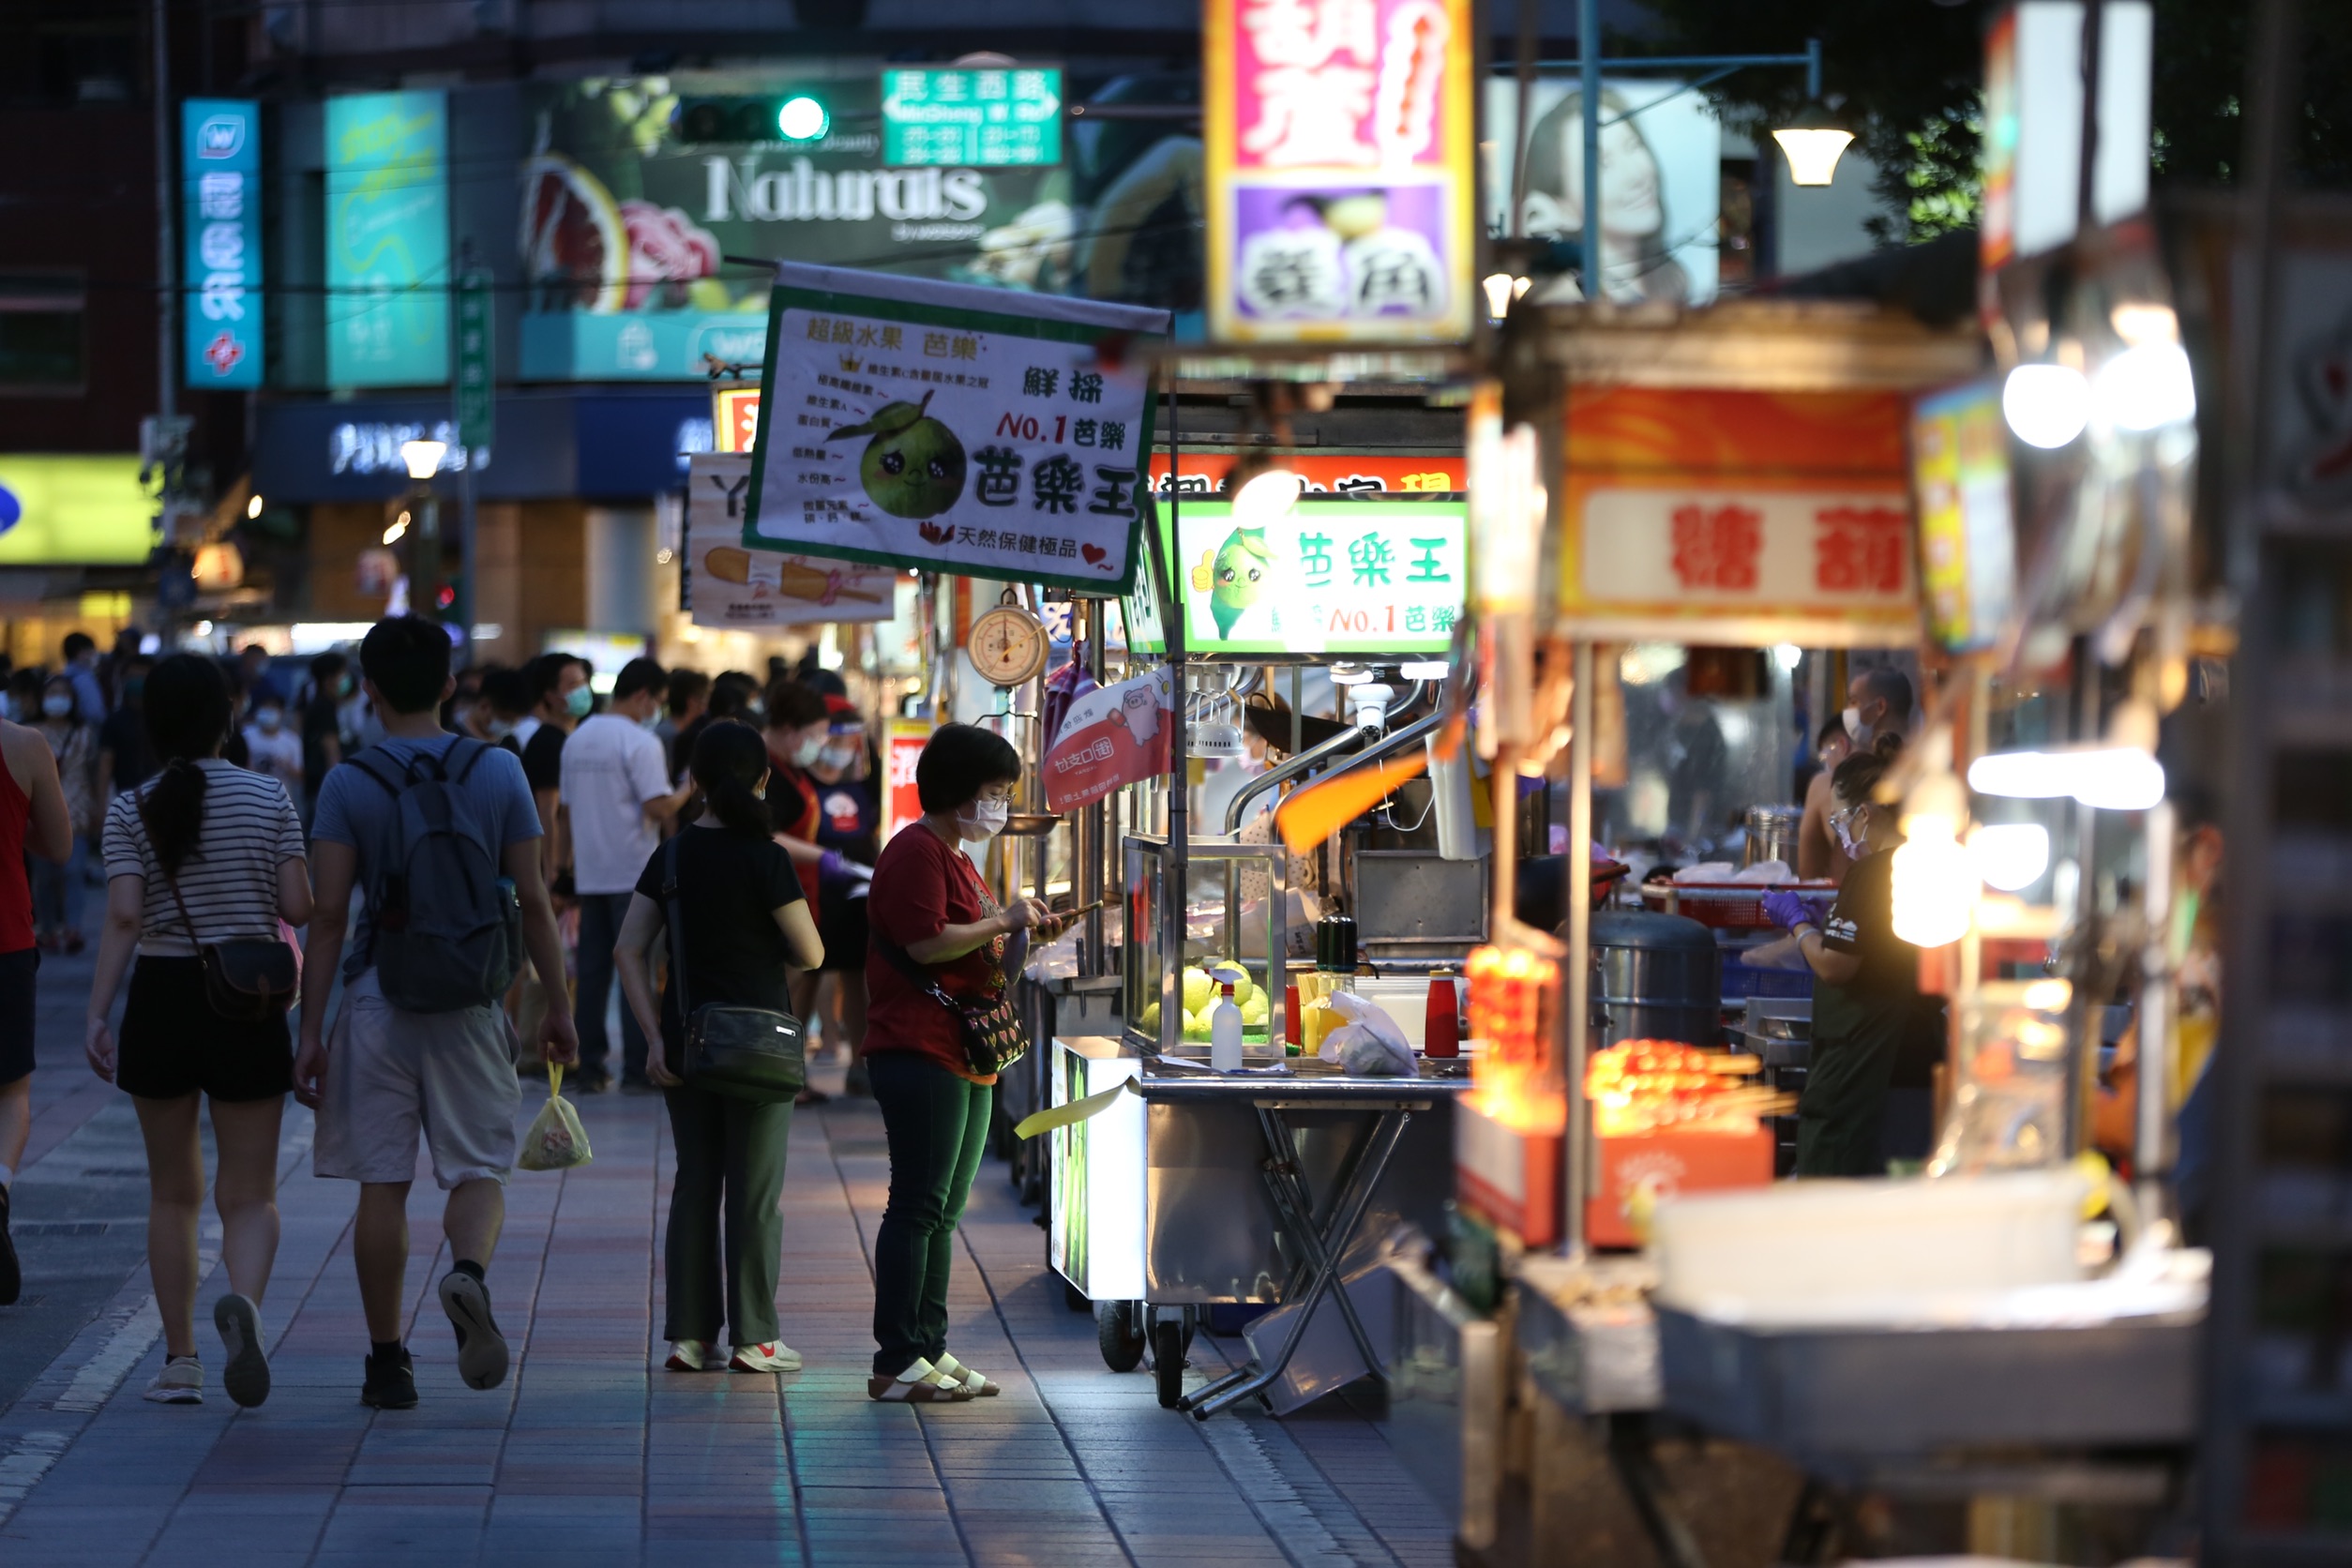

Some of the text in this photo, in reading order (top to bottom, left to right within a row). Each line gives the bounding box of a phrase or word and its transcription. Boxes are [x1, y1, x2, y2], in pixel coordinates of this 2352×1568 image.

[703, 155, 988, 221] Naturals
[807, 316, 977, 361] 超級水果 芭樂
[1022, 365, 1104, 404] 鮮採
[797, 472, 832, 486] 水份高
[973, 446, 1138, 520] 芭樂王
[957, 525, 1078, 560] 天然保健極品
[1298, 531, 1452, 589] 芭樂王
